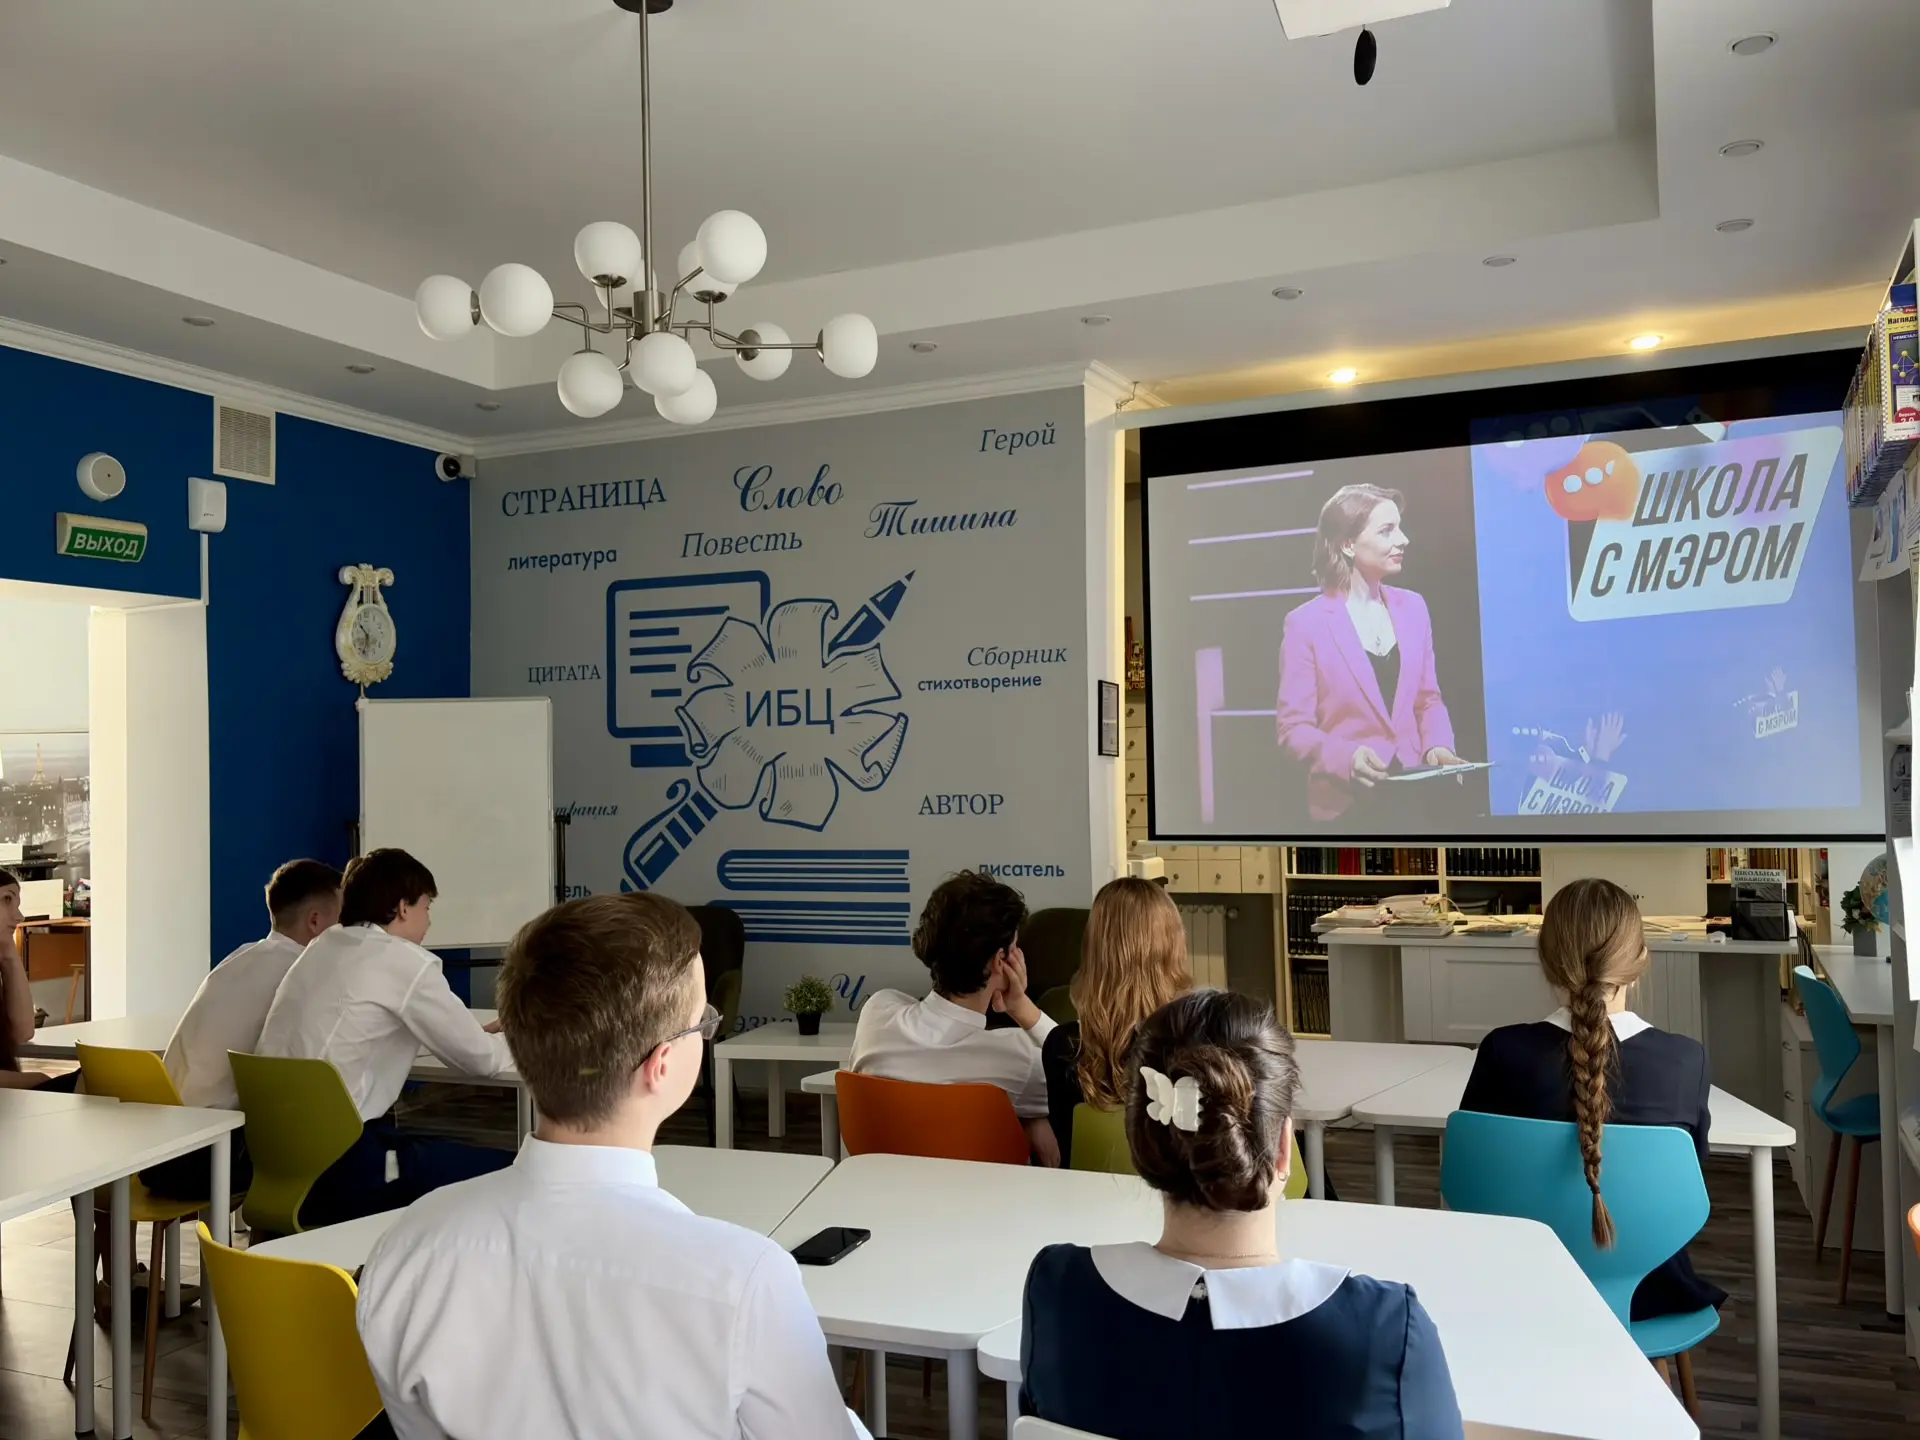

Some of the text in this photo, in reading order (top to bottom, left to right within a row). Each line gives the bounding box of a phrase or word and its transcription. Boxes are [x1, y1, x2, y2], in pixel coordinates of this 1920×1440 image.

[978, 422, 1056, 456] Герой
[501, 477, 667, 517] СТРАНИЦА
[733, 463, 844, 513] Слово
[1632, 453, 1809, 527] ШКОЛА
[864, 500, 1018, 539] Тишина
[74, 533, 139, 557] ВЫХОД
[680, 531, 803, 559] Повесть
[507, 546, 618, 573] литература
[1590, 522, 1805, 598] С МЭРОМ
[967, 645, 1068, 670] Сборник
[527, 664, 602, 685] ЦИТАТА
[917, 673, 1043, 692] стихотворение
[746, 688, 835, 734] ИБЦ
[918, 794, 1004, 815] АВТОР
[1528, 789, 1544, 810] С
[979, 864, 1065, 877] писатель
